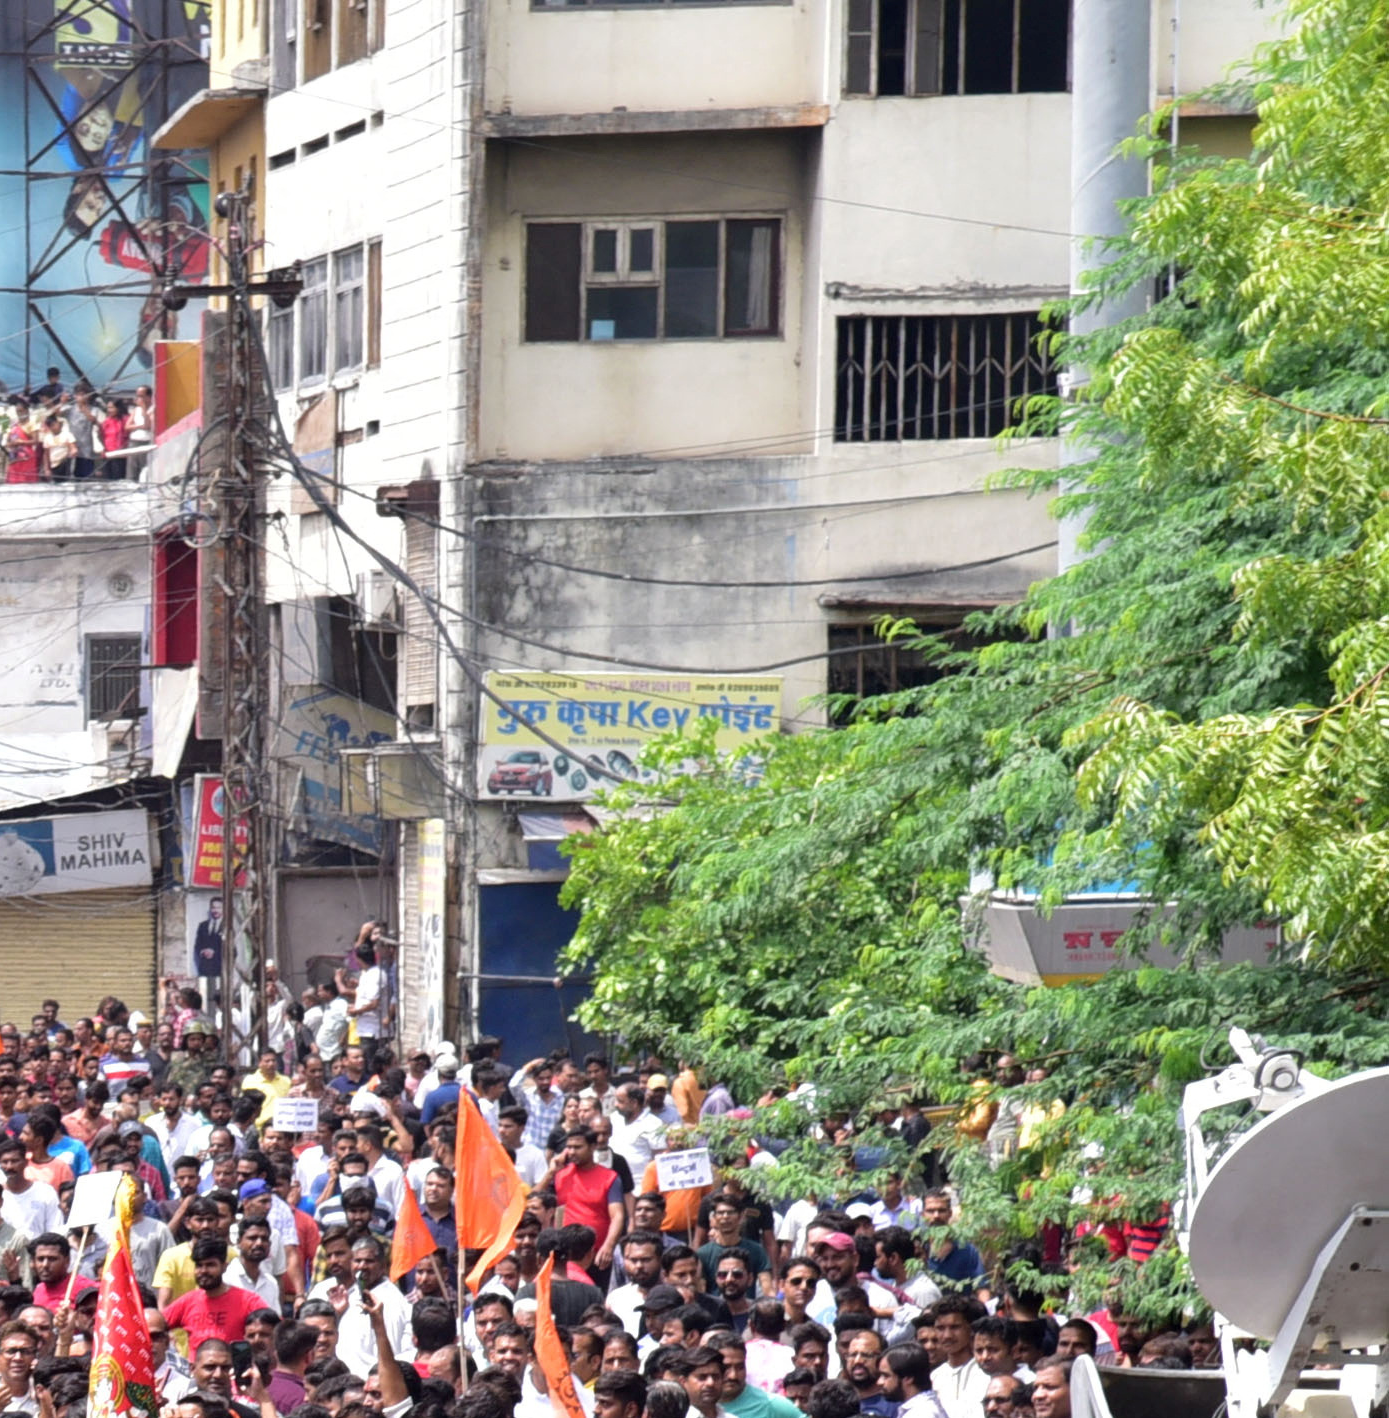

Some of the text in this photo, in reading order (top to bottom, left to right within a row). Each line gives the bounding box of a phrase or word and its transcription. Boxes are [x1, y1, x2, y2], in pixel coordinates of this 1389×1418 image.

[627, 700, 690, 730] Key
[76, 832, 126, 852] SHIV
[60, 848, 146, 872] MAHIMA
